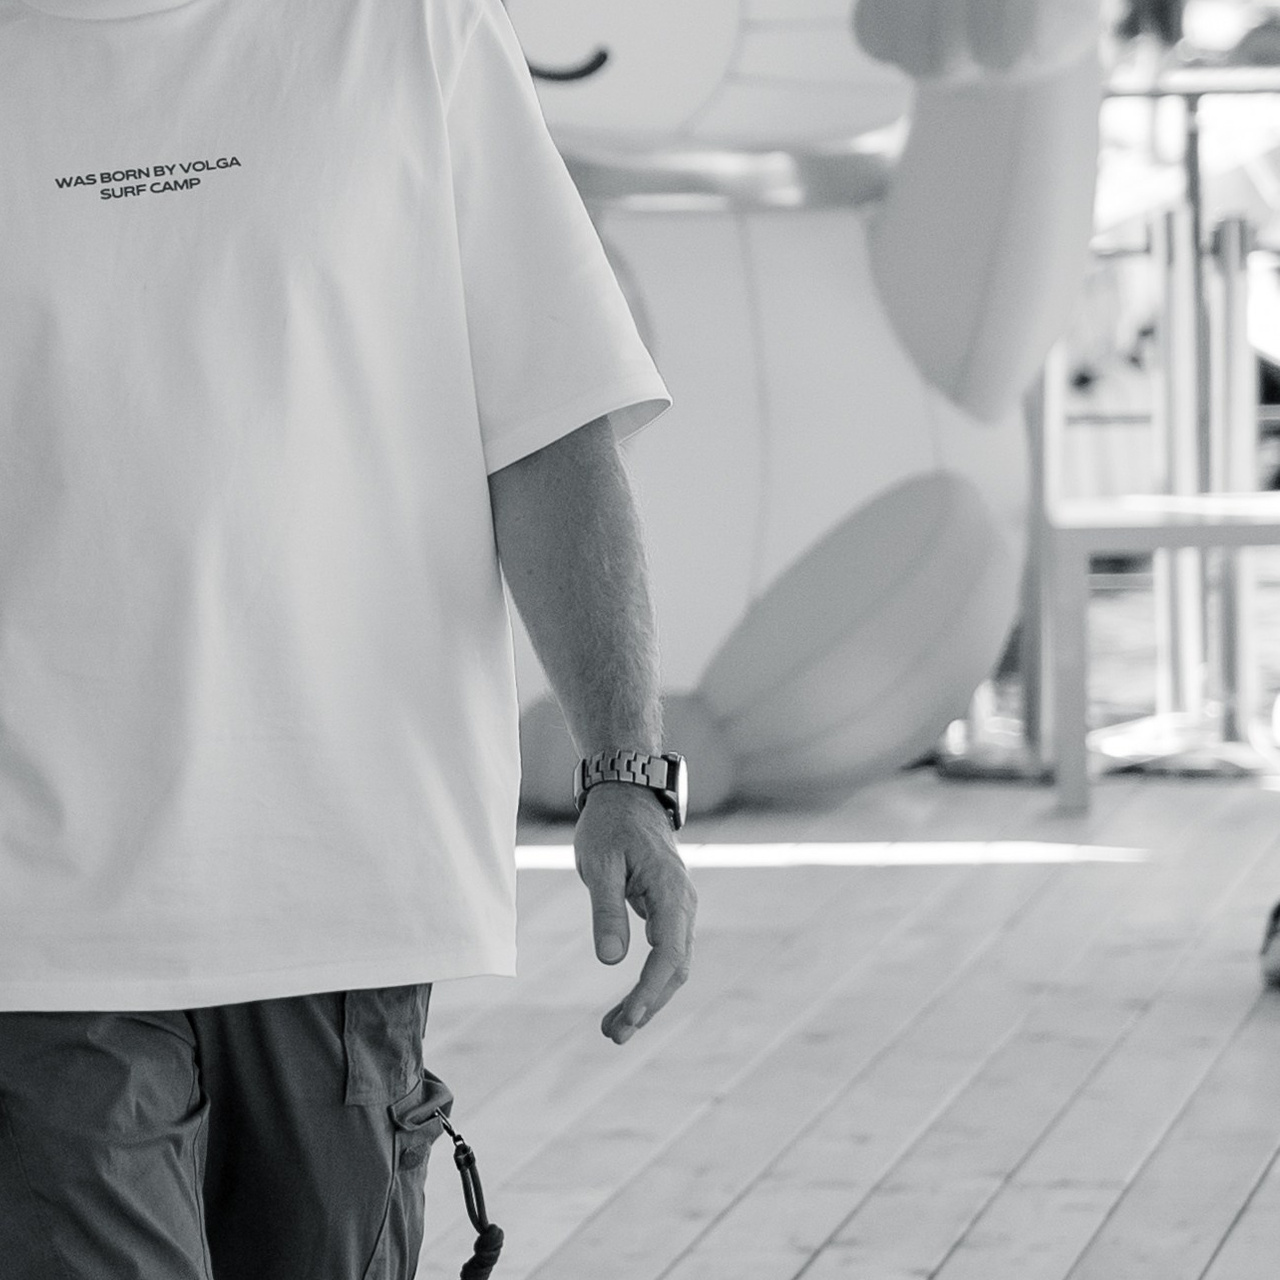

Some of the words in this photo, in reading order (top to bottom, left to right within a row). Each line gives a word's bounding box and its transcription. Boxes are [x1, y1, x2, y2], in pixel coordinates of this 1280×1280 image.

[54, 173, 98, 189] WAS
[99, 166, 151, 184] BORN
[152, 163, 177, 178] BY
[178, 156, 242, 175] VOLGA
[99, 183, 147, 201] SURF
[149, 177, 202, 195] CAMP
